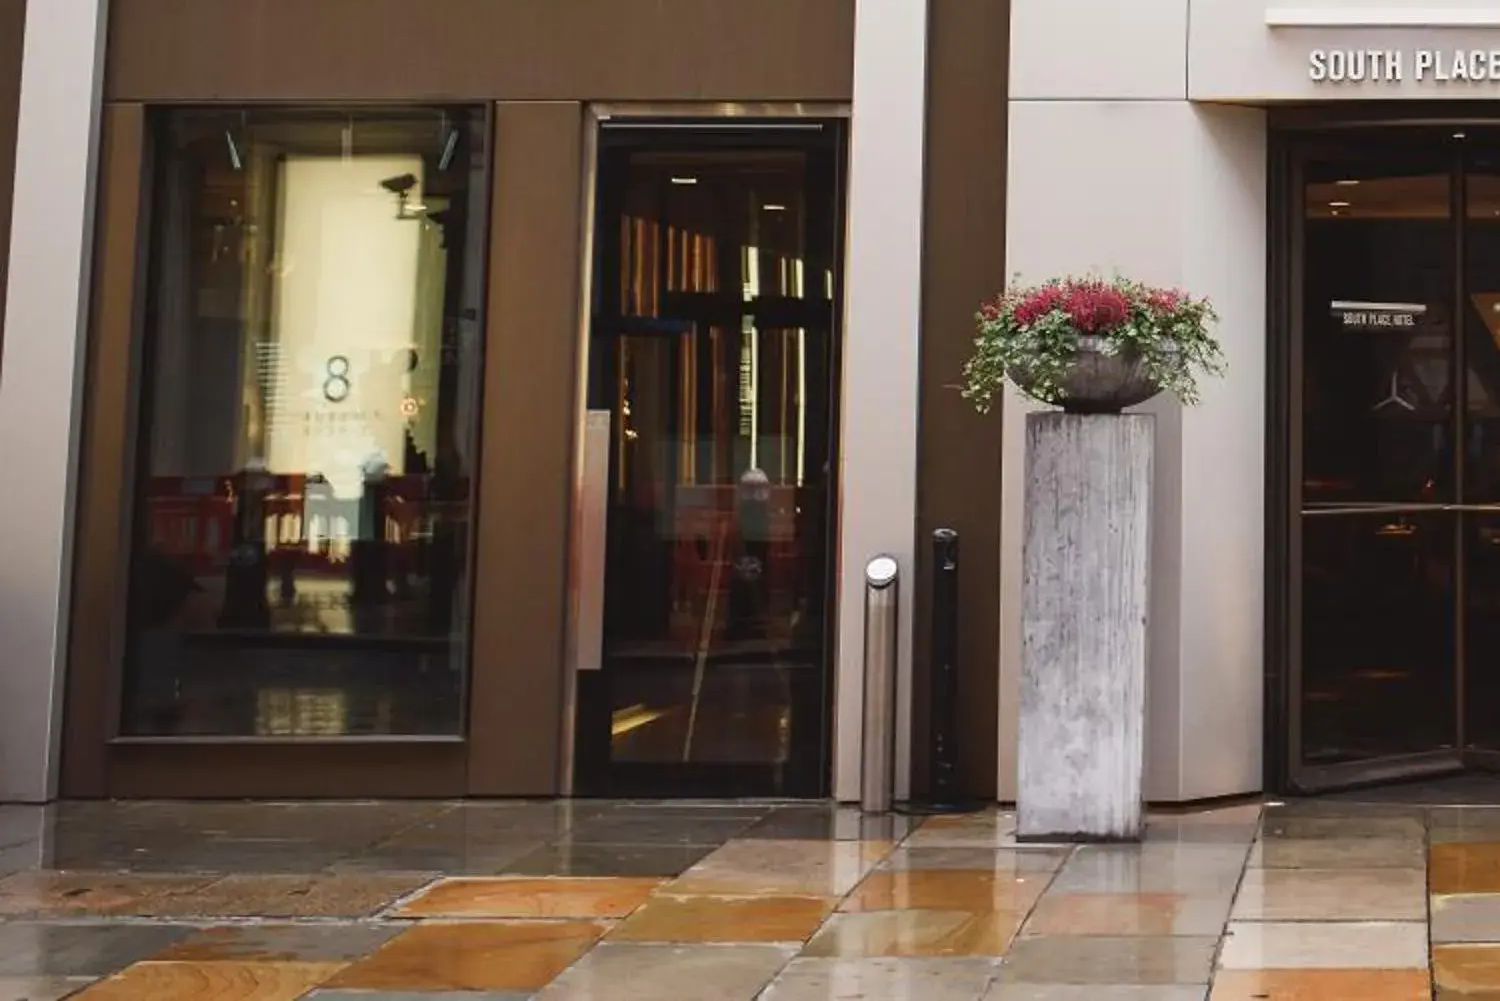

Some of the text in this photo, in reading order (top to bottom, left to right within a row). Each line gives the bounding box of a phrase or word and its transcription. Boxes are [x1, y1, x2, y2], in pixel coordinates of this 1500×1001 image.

[1308, 49, 1402, 83] SOUTH
[1368, 313, 1392, 326] PLACE
[323, 355, 350, 403] 8
